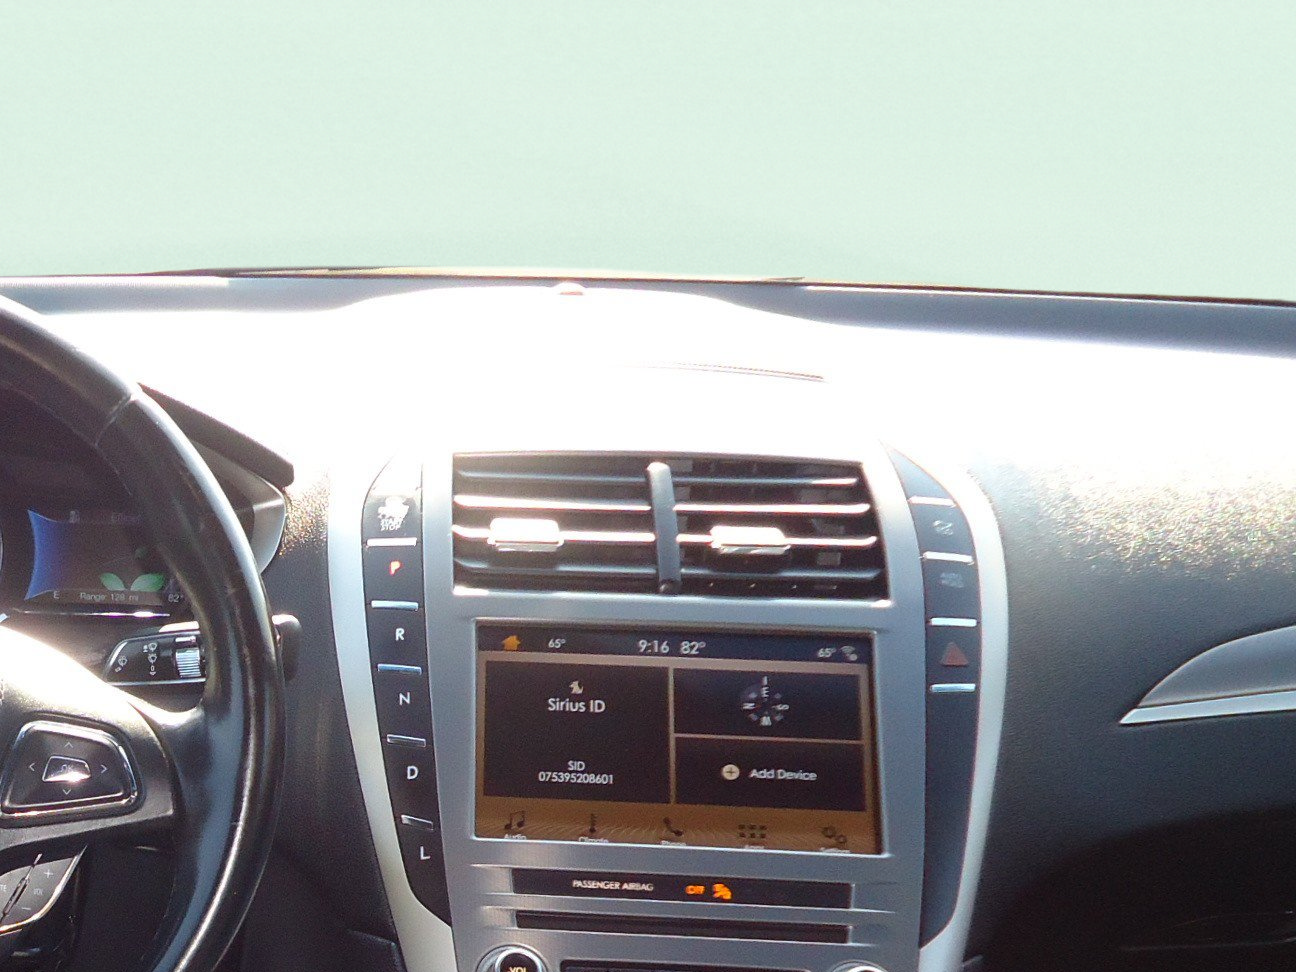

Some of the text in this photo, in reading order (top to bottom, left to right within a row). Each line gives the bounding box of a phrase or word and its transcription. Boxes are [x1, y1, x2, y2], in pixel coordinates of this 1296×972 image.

[389, 560, 401, 575] P
[395, 627, 404, 641] R
[548, 638, 566, 649] 65°
[638, 639, 706, 655] 9:16 82°
[399, 692, 411, 706] N
[547, 697, 606, 713] Sirius ID
[406, 765, 419, 780] D
[567, 760, 586, 771] SID
[538, 771, 614, 784] 075395208601
[749, 769, 817, 781] Add Device
[420, 845, 430, 860] L
[572, 879, 654, 891] PASSENGER AIRBAG
